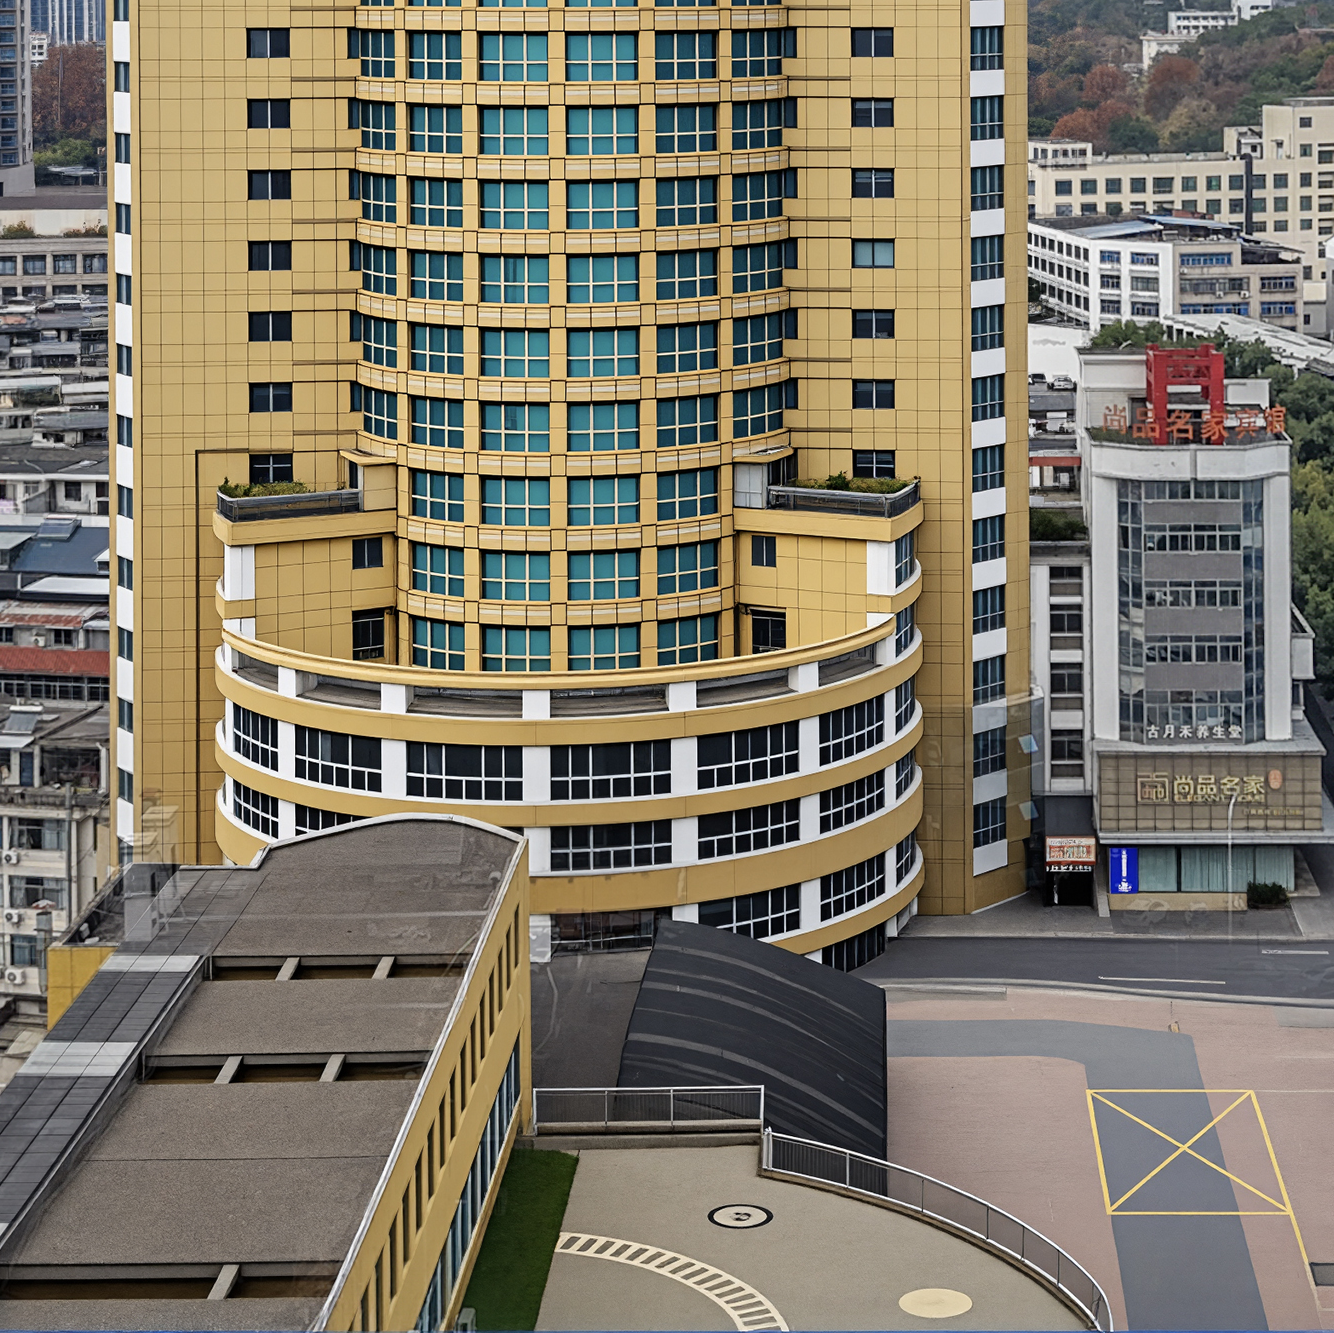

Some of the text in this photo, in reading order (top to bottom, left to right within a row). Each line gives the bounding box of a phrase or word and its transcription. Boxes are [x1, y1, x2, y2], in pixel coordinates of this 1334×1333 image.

[1102, 403, 1287, 440] 尚品名家宾馆
[1146, 724, 1243, 739] 古月禾养生堂
[1173, 775, 1265, 795] 尚品名家
